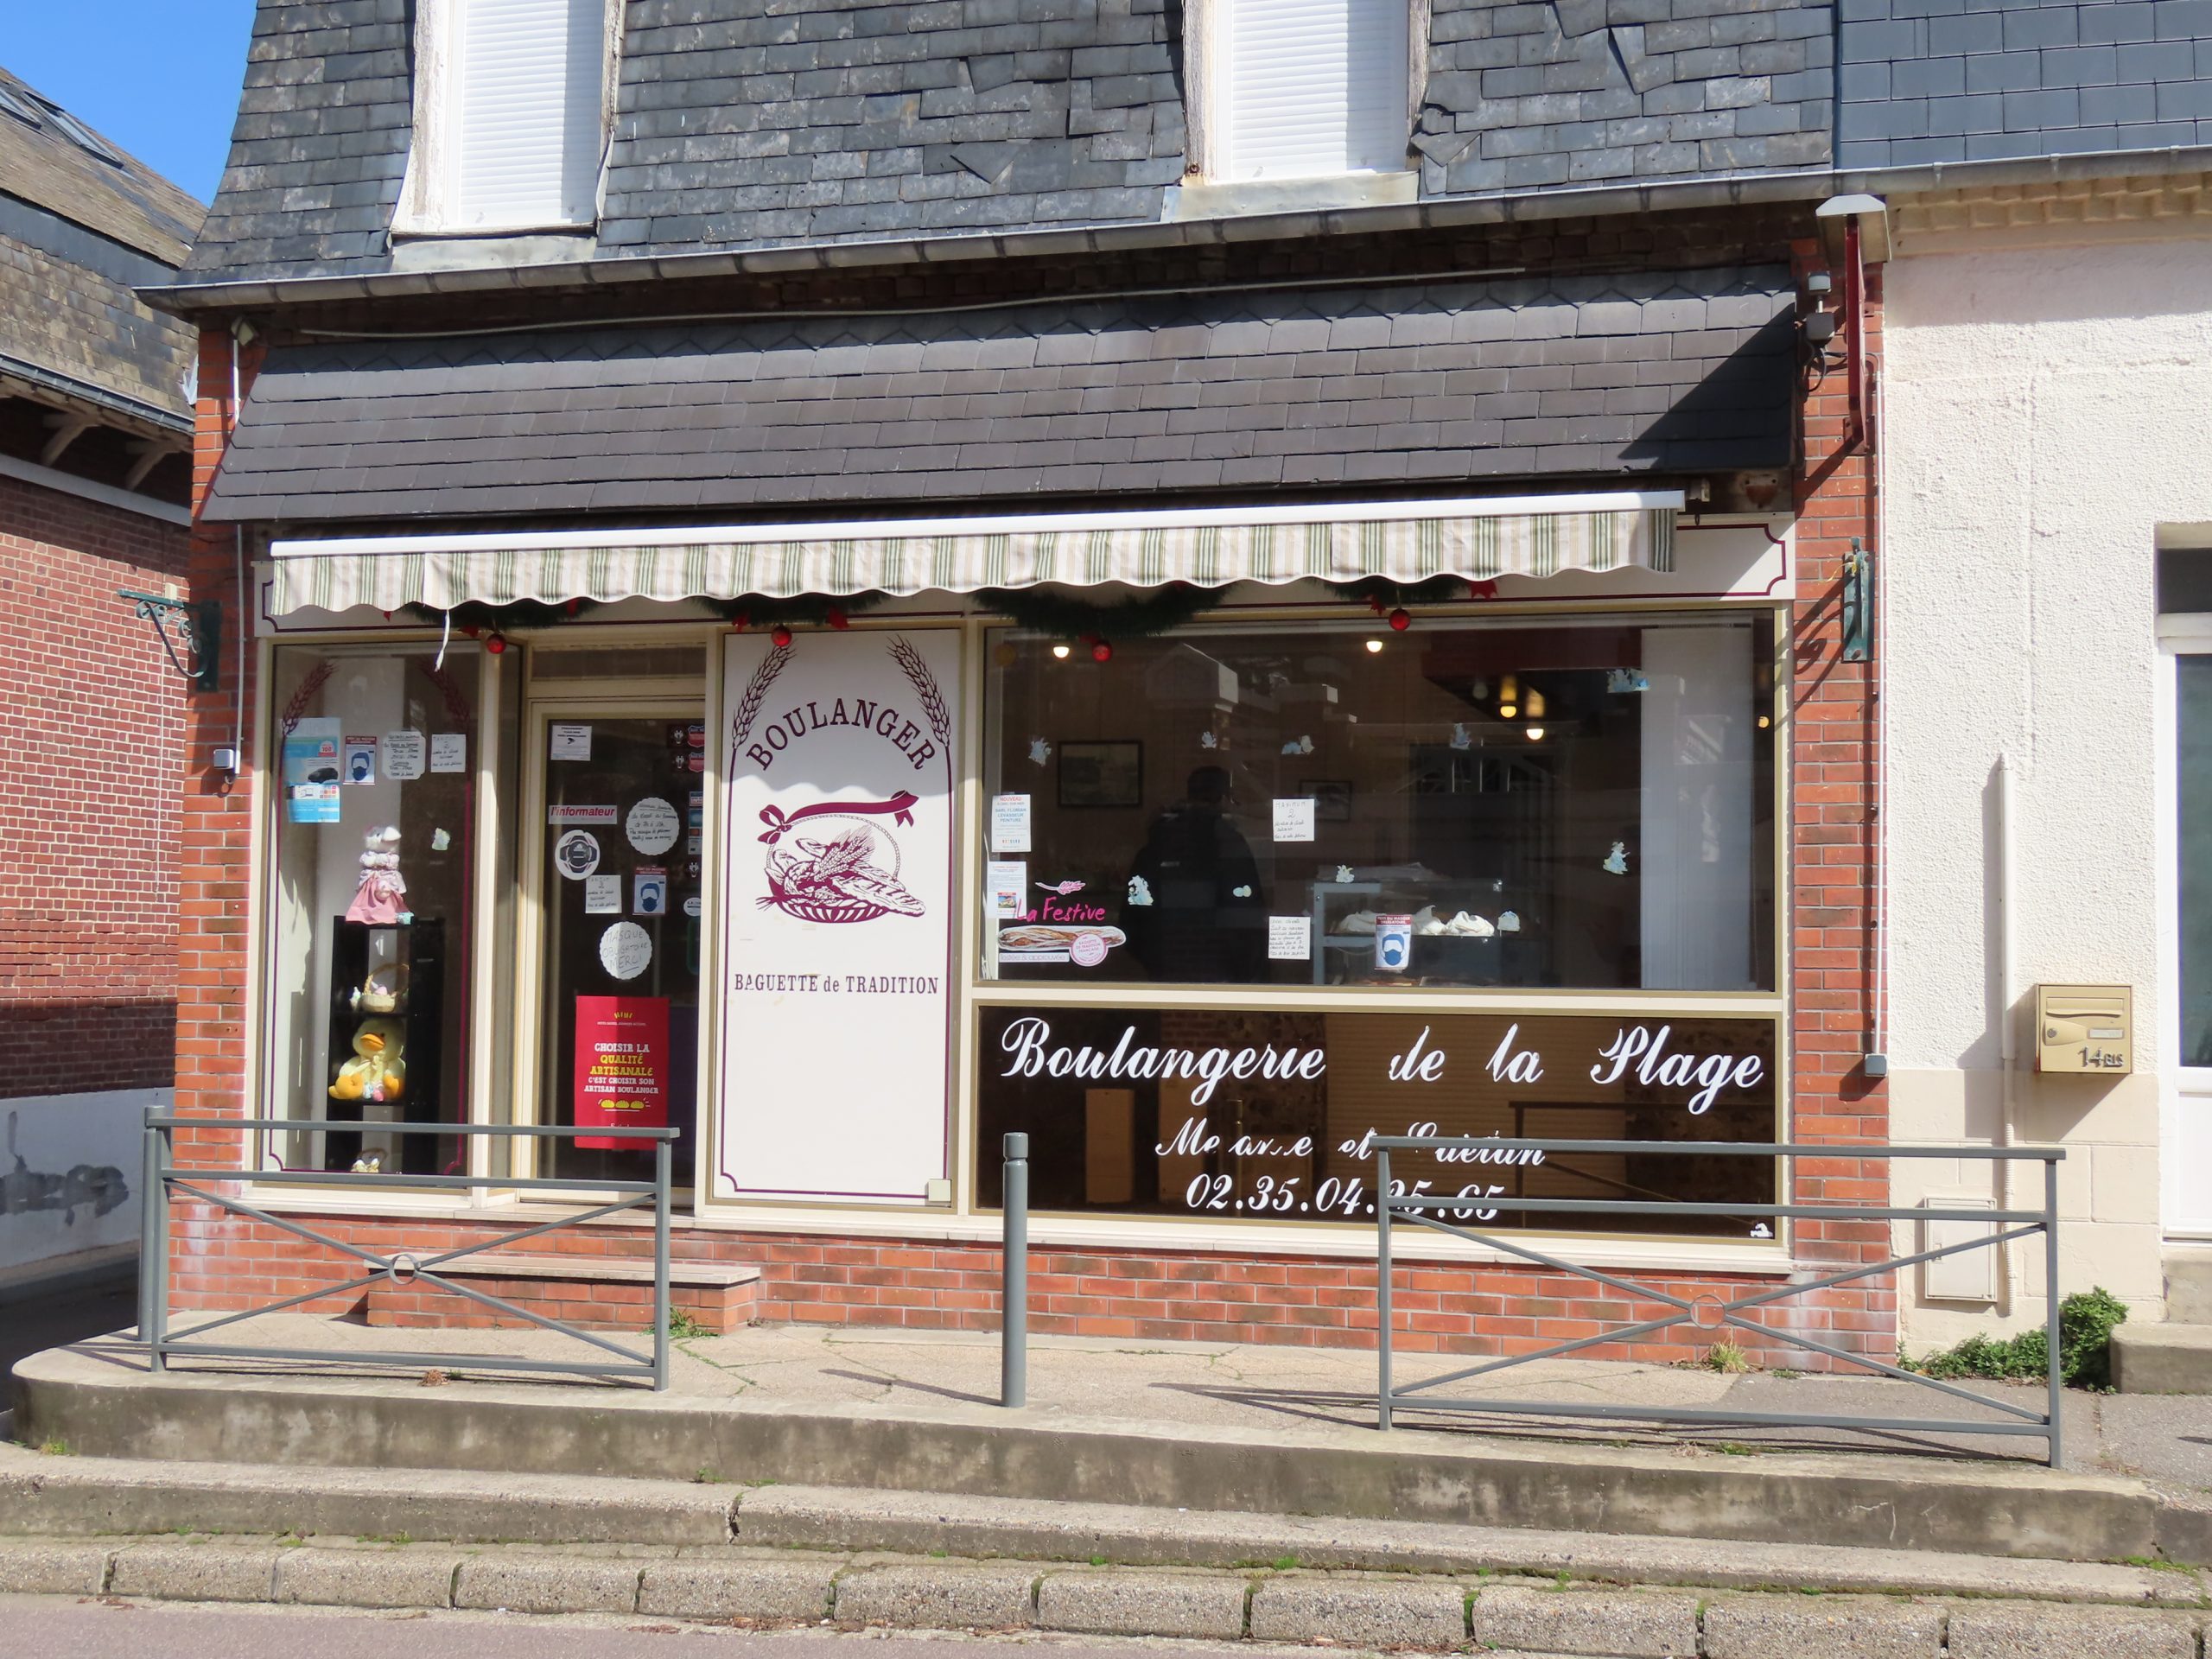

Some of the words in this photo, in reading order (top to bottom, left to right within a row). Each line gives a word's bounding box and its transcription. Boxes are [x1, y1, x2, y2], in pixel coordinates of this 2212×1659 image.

[746, 698, 935, 771] BOULANGER
[550, 806, 615, 817] l'informateur
[1016, 899, 1037, 922] La
[1043, 896, 1106, 922] Festive
[607, 930, 644, 942] MASQUE
[734, 974, 817, 992] BAGUETTE
[823, 976, 839, 992] de
[846, 976, 938, 994] TRADITION
[594, 1042, 633, 1052] CHOISIR
[637, 1043, 650, 1053] LA
[601, 1053, 644, 1065] QUALITÉ
[589, 1065, 653, 1077] ARTISANALE
[1001, 1017, 1327, 1107] Boulangerie
[1389, 1025, 1444, 1083] de
[1488, 1023, 1543, 1084] la
[1590, 1025, 1764, 1116] Plage
[608, 1077, 637, 1085] CHOISIR
[584, 1084, 615, 1093] ARTISAN
